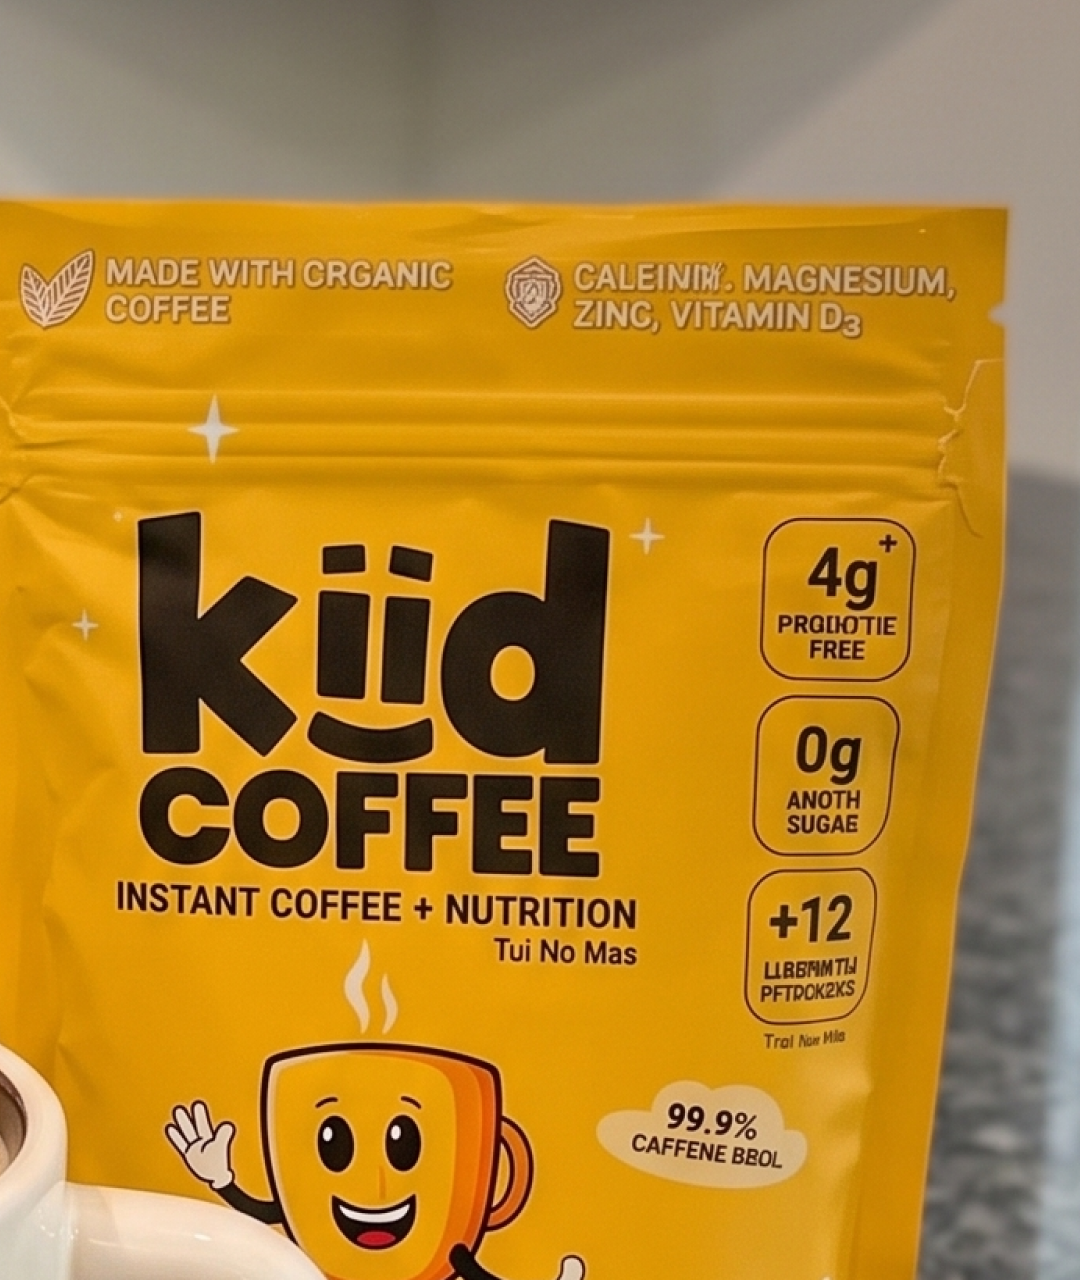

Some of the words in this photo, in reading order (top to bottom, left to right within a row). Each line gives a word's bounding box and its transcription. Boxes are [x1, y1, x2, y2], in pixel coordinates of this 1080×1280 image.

[105, 258, 199, 287] MADE
[208, 258, 295, 288] WITH
[744, 265, 956, 300] MAGNESIUM,
[105, 294, 231, 323] COFFEE
[573, 300, 660, 333] ZINC,
[671, 301, 810, 331] VITAMIN
[809, 639, 866, 661] FREE
[796, 725, 862, 786] 0g
[786, 790, 861, 810] ANOTH
[139, 765, 601, 878] COFFEE
[117, 881, 261, 918] INSTANT
[270, 886, 402, 922] COFFEE
[445, 894, 638, 930] NUTRITION
[769, 893, 853, 943] +12
[493, 936, 531, 963] Tui
[540, 939, 576, 965] No
[584, 940, 638, 966] Mas
[667, 1102, 758, 1141] 99.9%
[631, 1132, 728, 1164] CAFFENE
